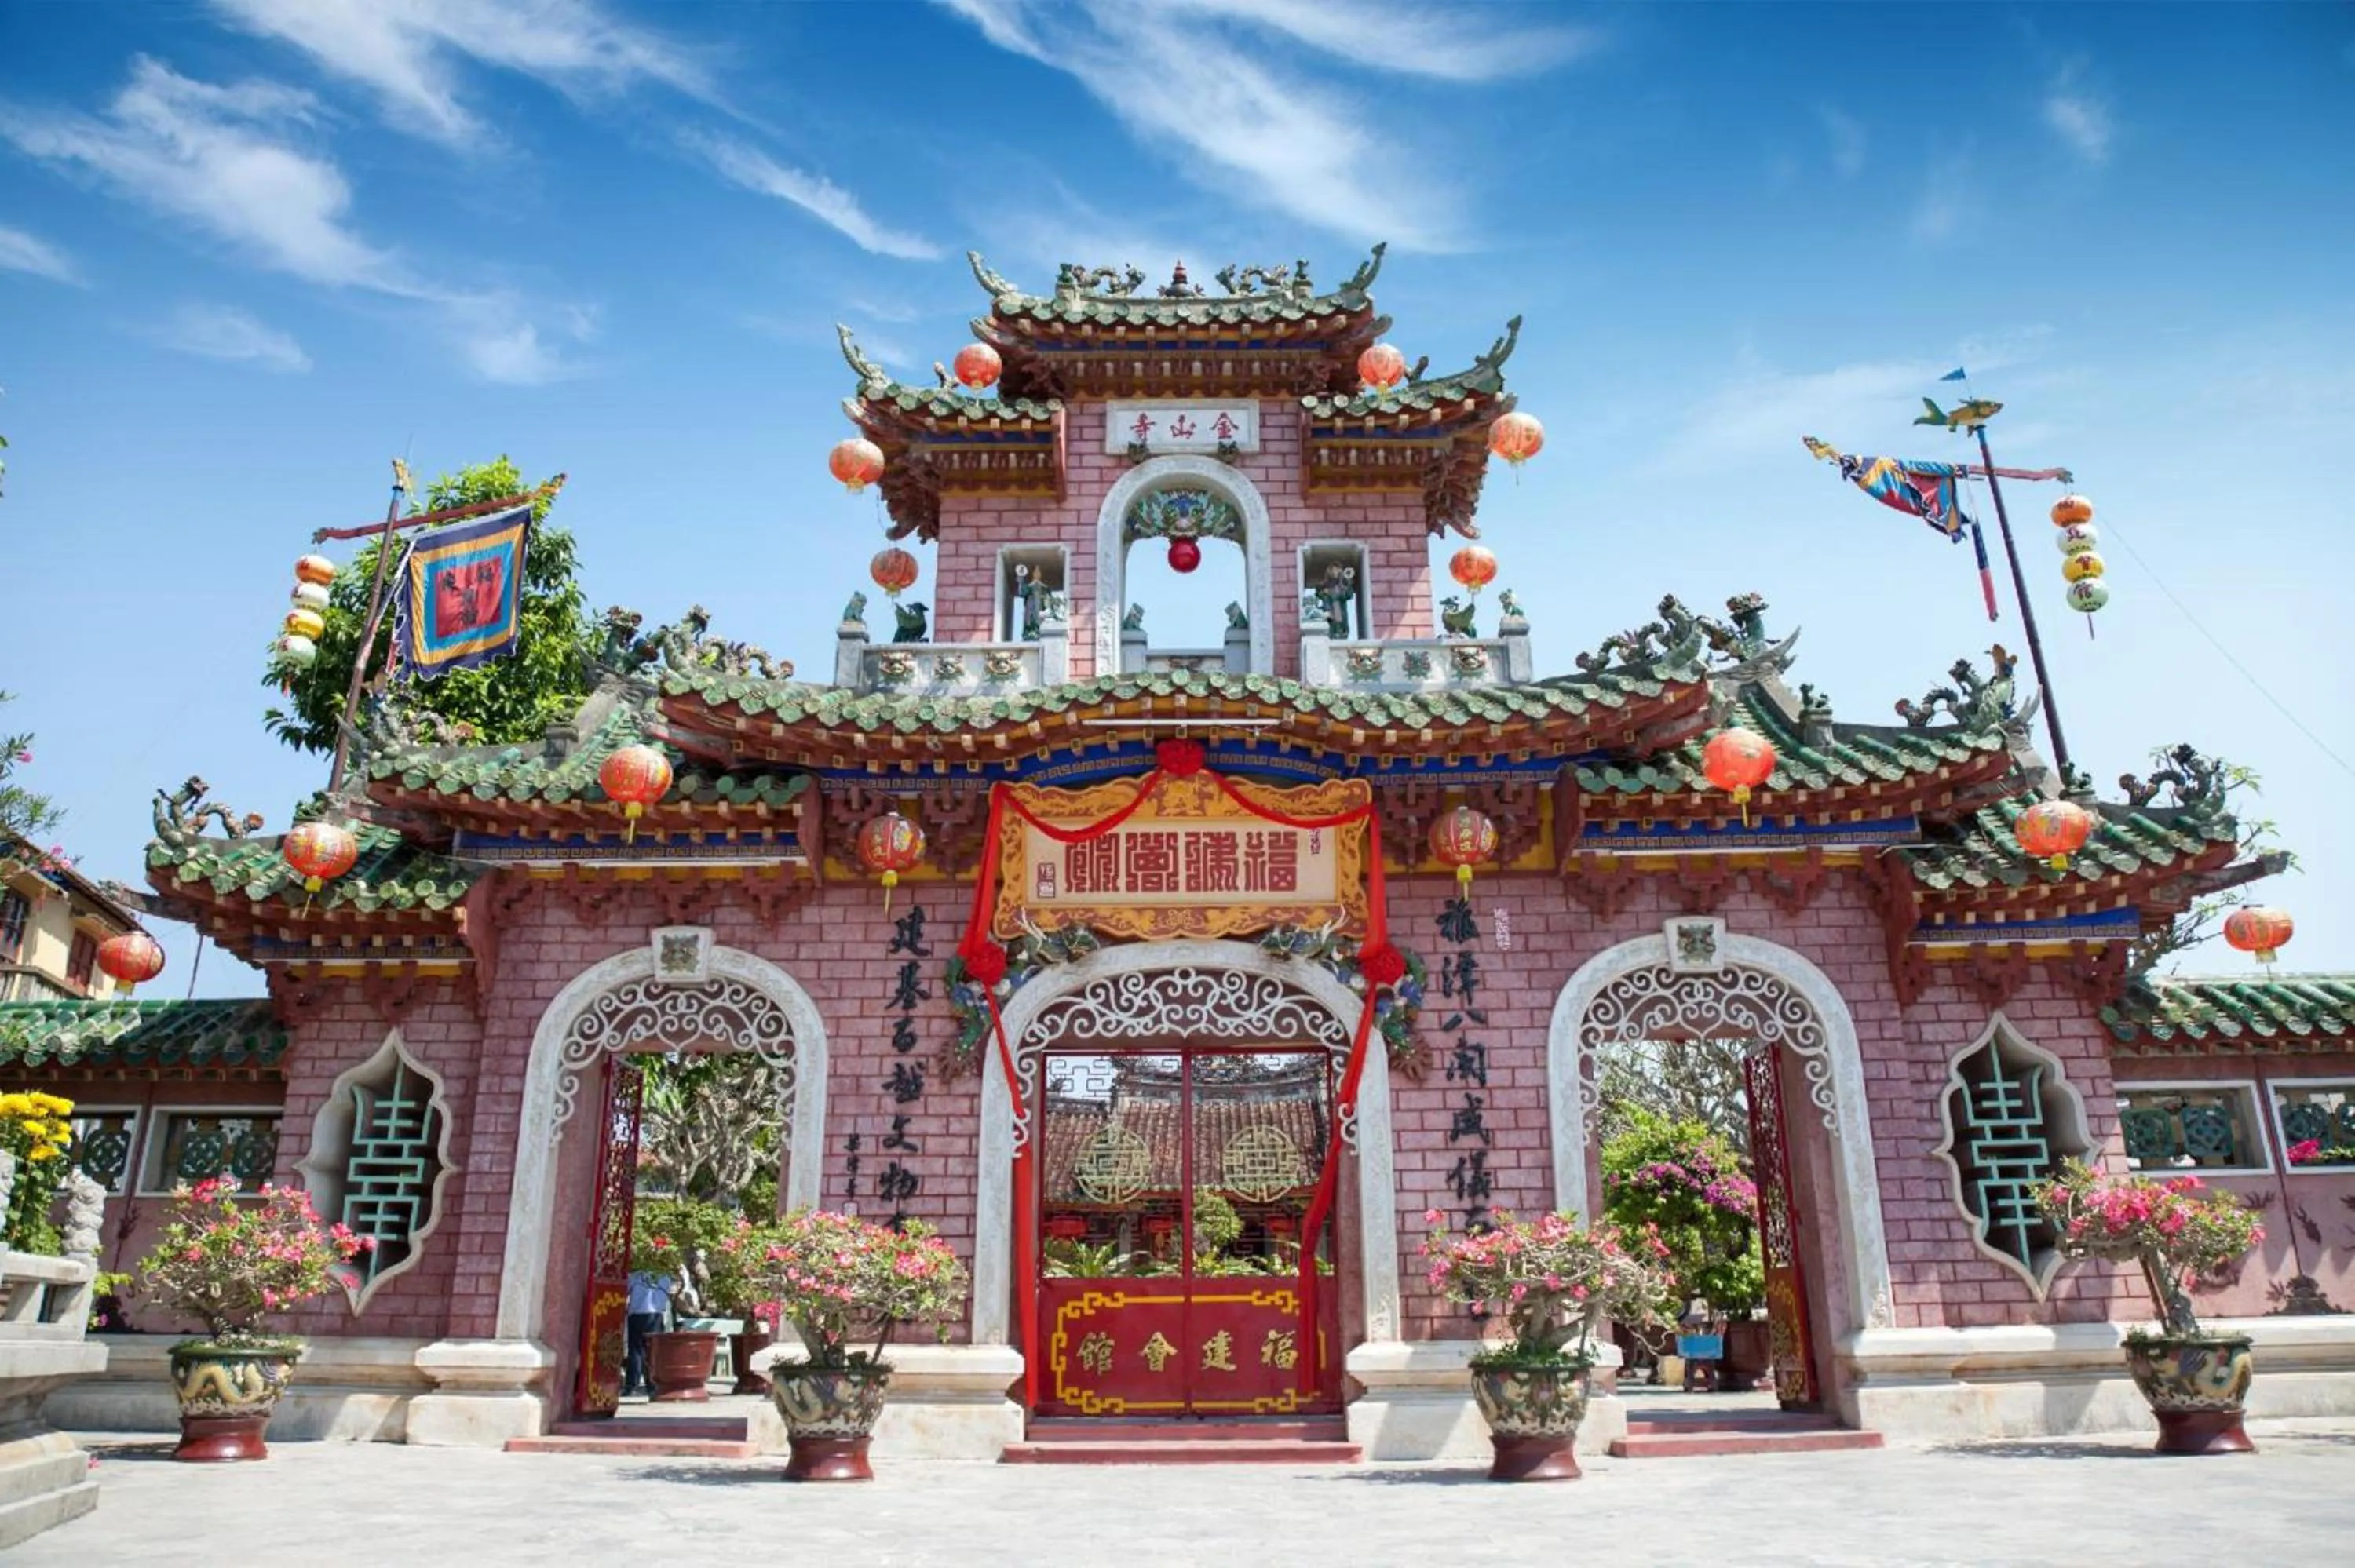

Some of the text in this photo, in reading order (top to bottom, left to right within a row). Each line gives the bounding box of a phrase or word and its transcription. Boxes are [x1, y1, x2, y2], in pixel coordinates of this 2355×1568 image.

[1130, 411, 1240, 445] 金山寺
[1076, 1329, 1298, 1375] 福建會館
